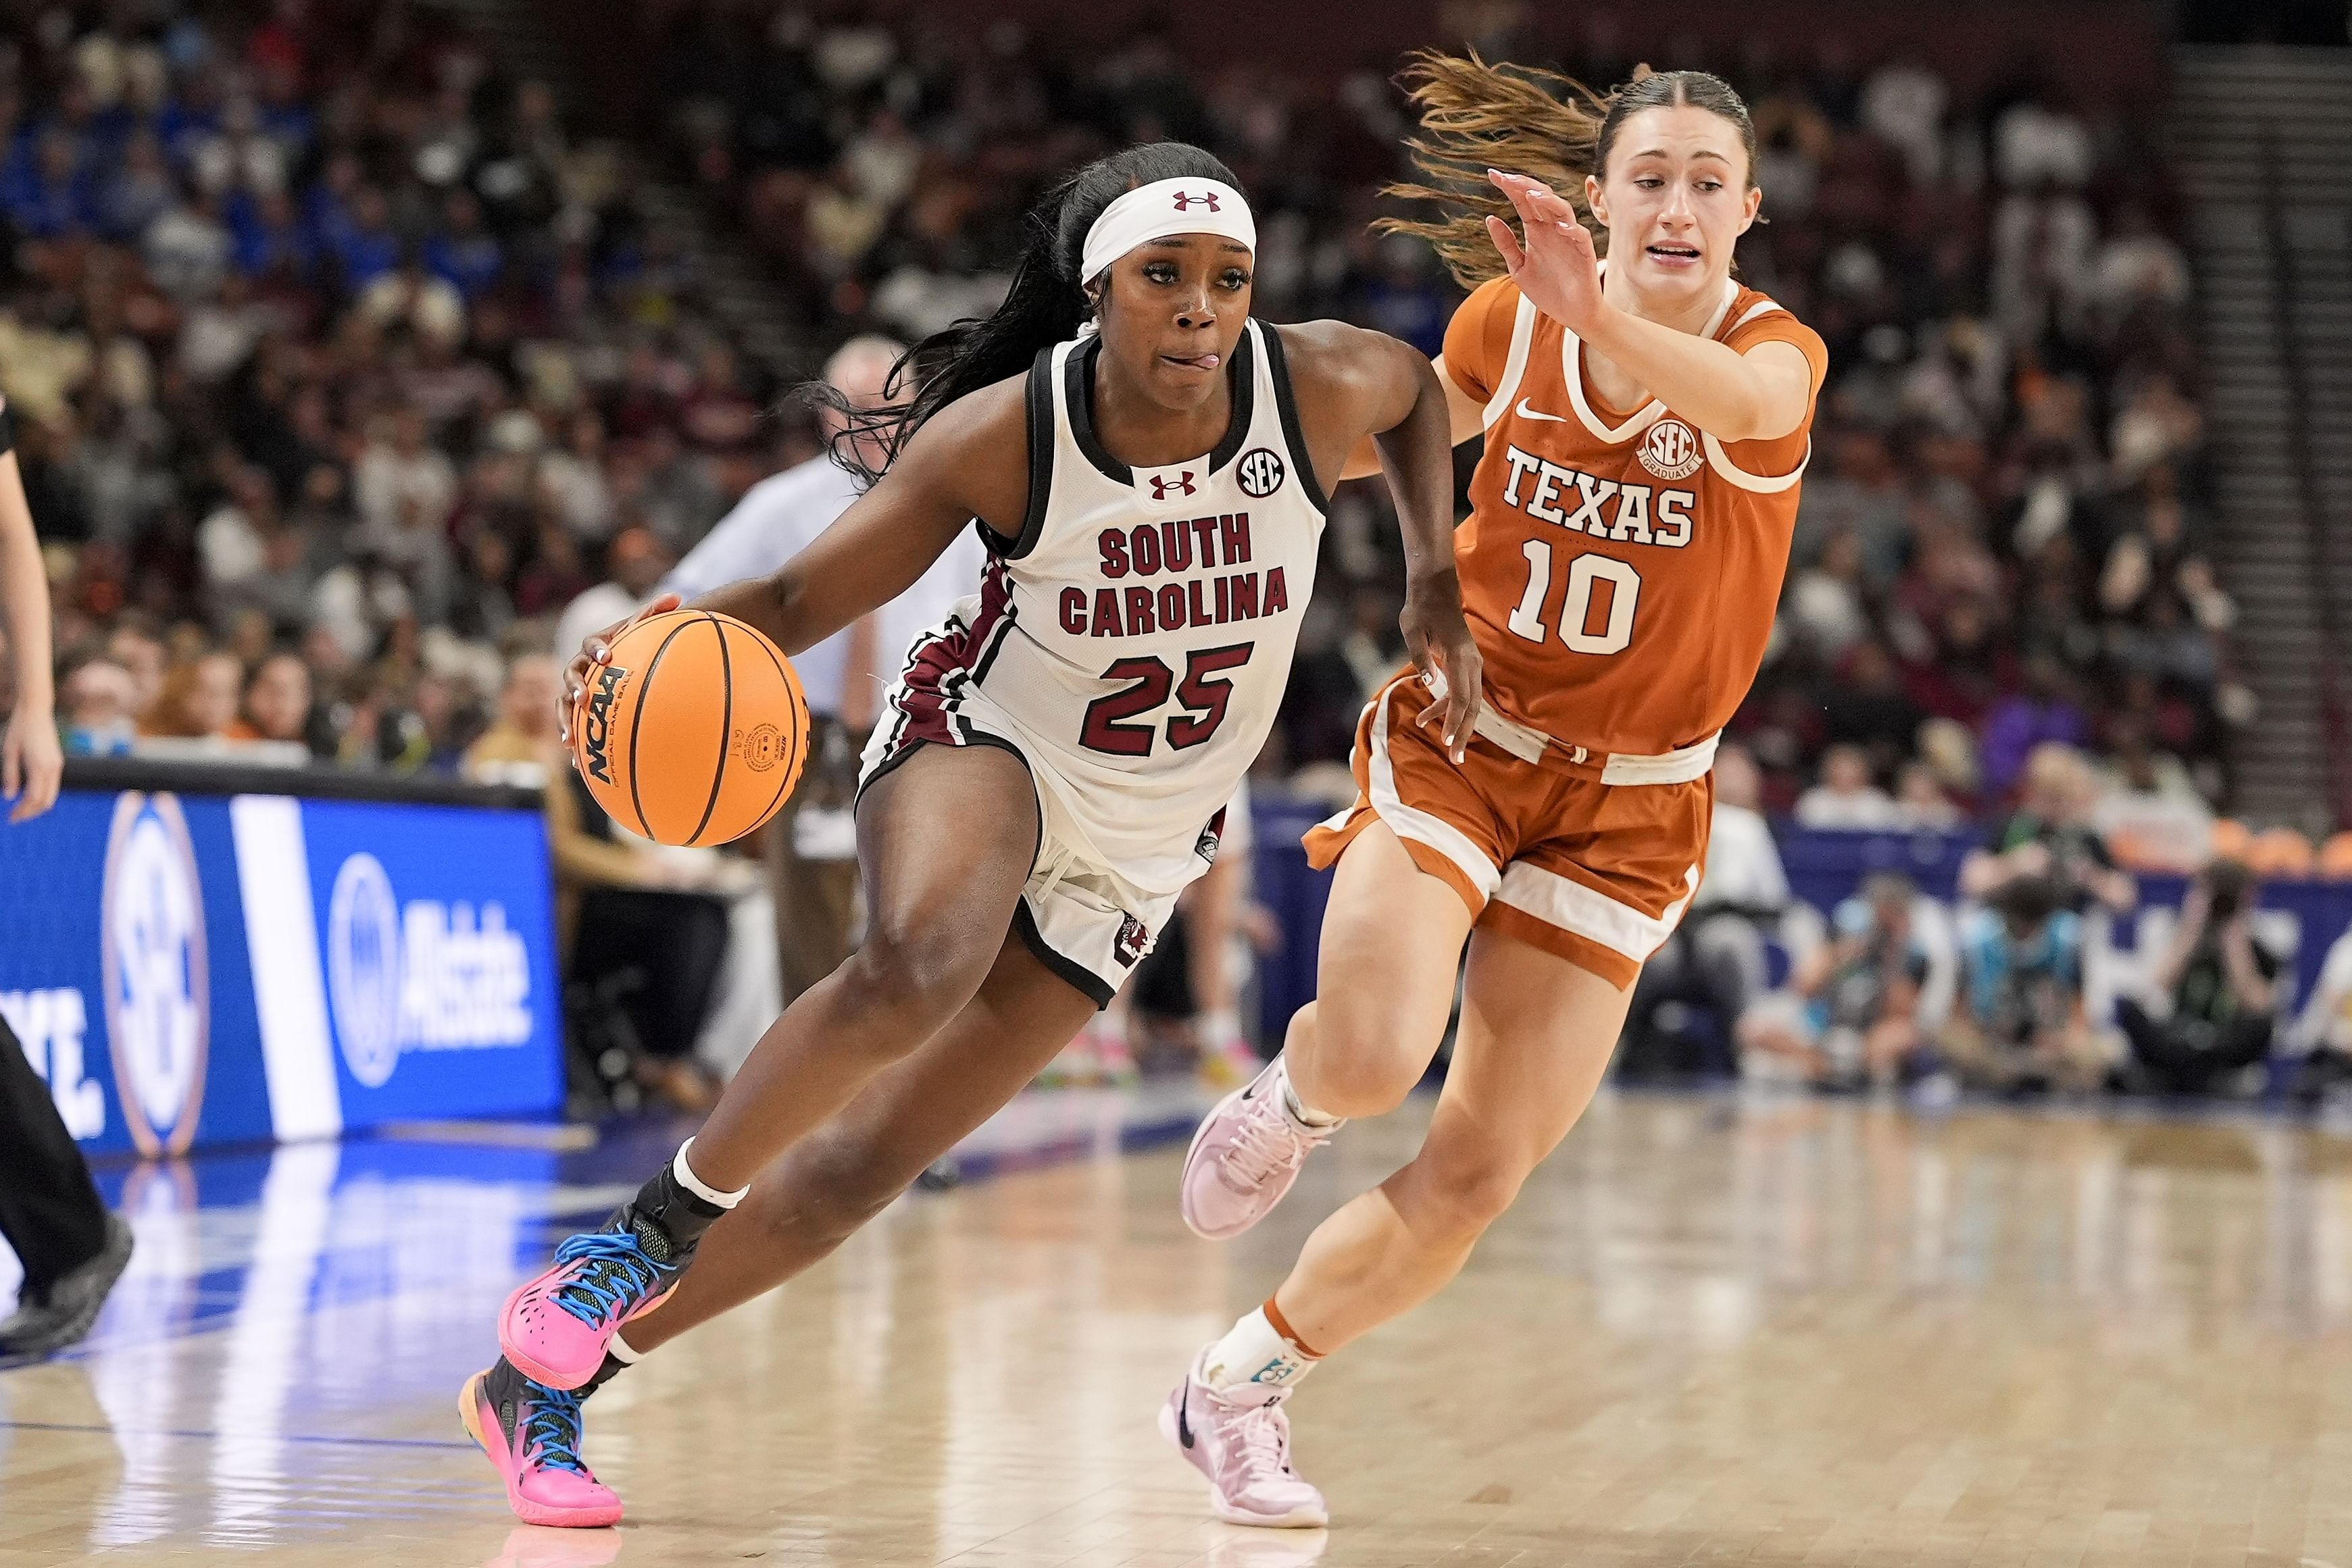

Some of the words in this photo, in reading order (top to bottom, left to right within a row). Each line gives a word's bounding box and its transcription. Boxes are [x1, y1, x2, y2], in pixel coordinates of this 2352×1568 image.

[1241, 452, 1281, 495] SEC
[1643, 459, 1694, 479] GRADUATE
[1650, 422, 1693, 466] SEC
[1503, 444, 1695, 548] TEXAS
[1098, 512, 1251, 578] SOUTH
[1059, 566, 1288, 637] CAROLINA
[1507, 538, 1642, 655] 10
[586, 665, 628, 786] NCAA
[609, 740, 619, 788] OFFICIAL
[618, 670, 634, 699] BALL
[1078, 641, 1255, 757] 25
